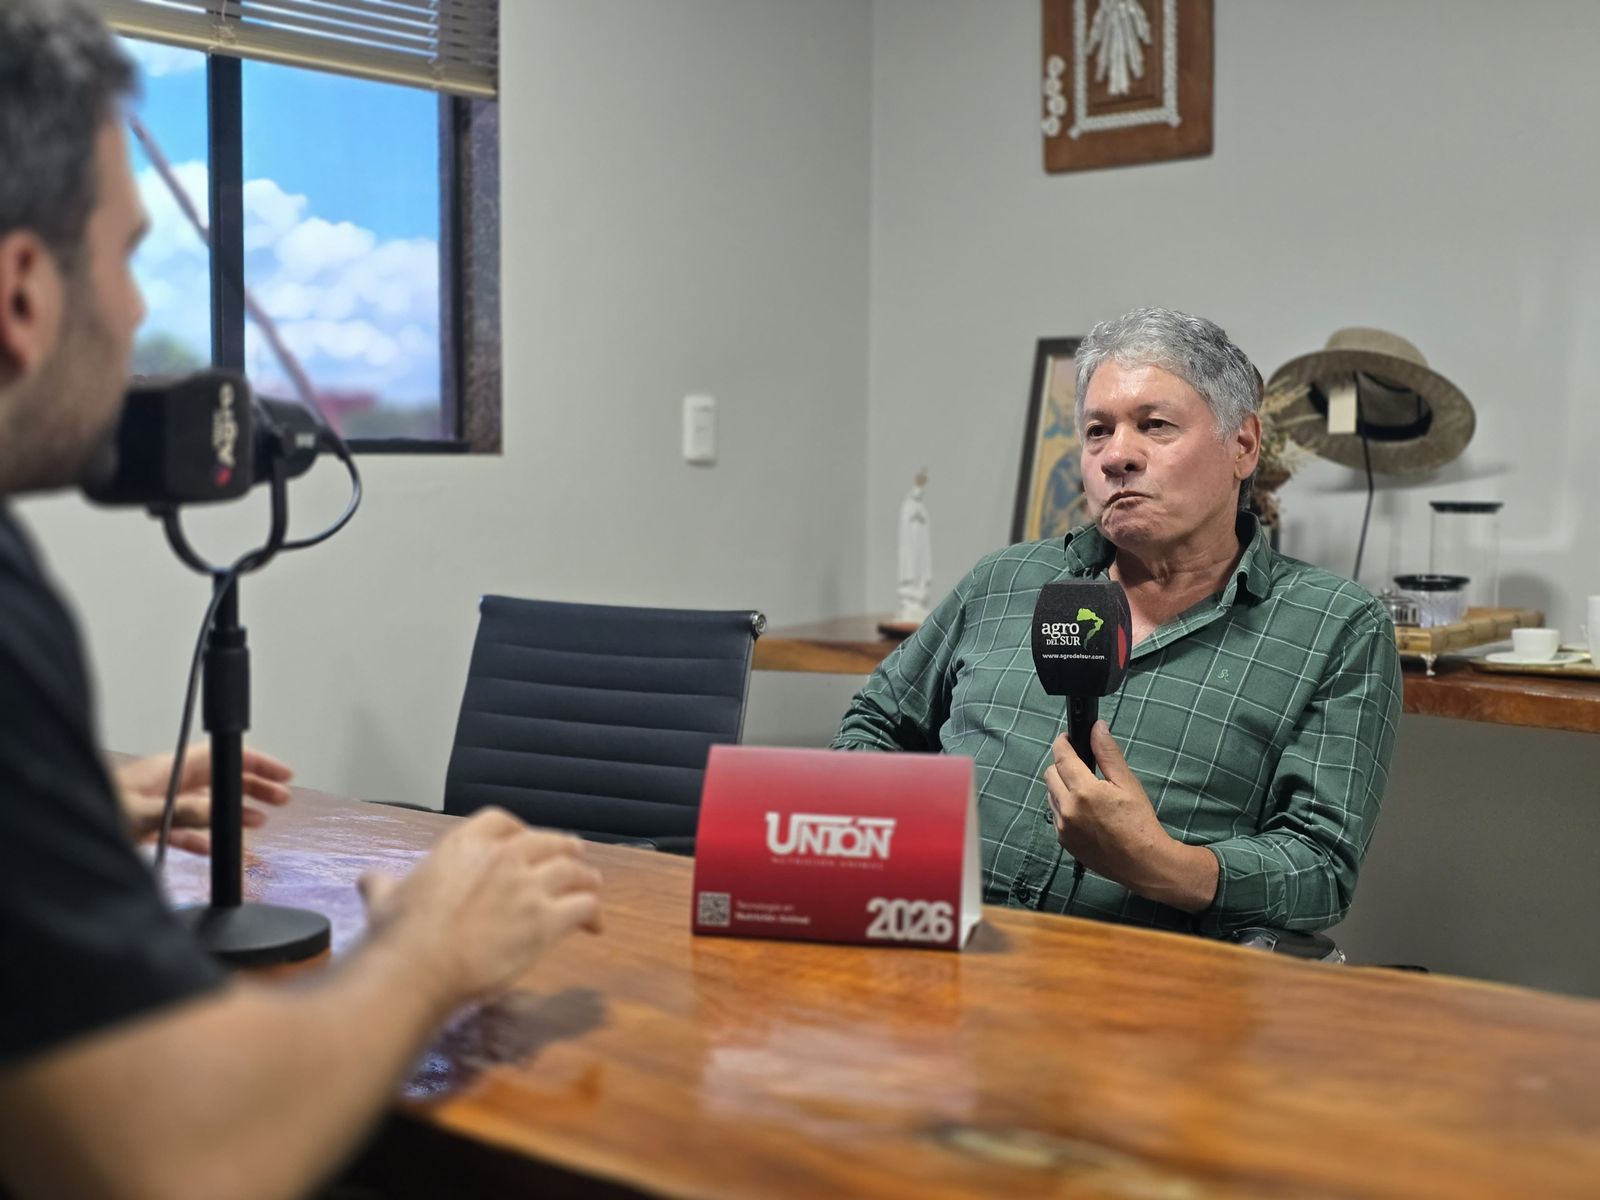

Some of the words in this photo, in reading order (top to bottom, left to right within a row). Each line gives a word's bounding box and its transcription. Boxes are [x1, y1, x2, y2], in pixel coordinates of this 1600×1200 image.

[1041, 622, 1080, 638] agro
[1060, 636, 1081, 646] SUR
[866, 898, 954, 942] 2026
